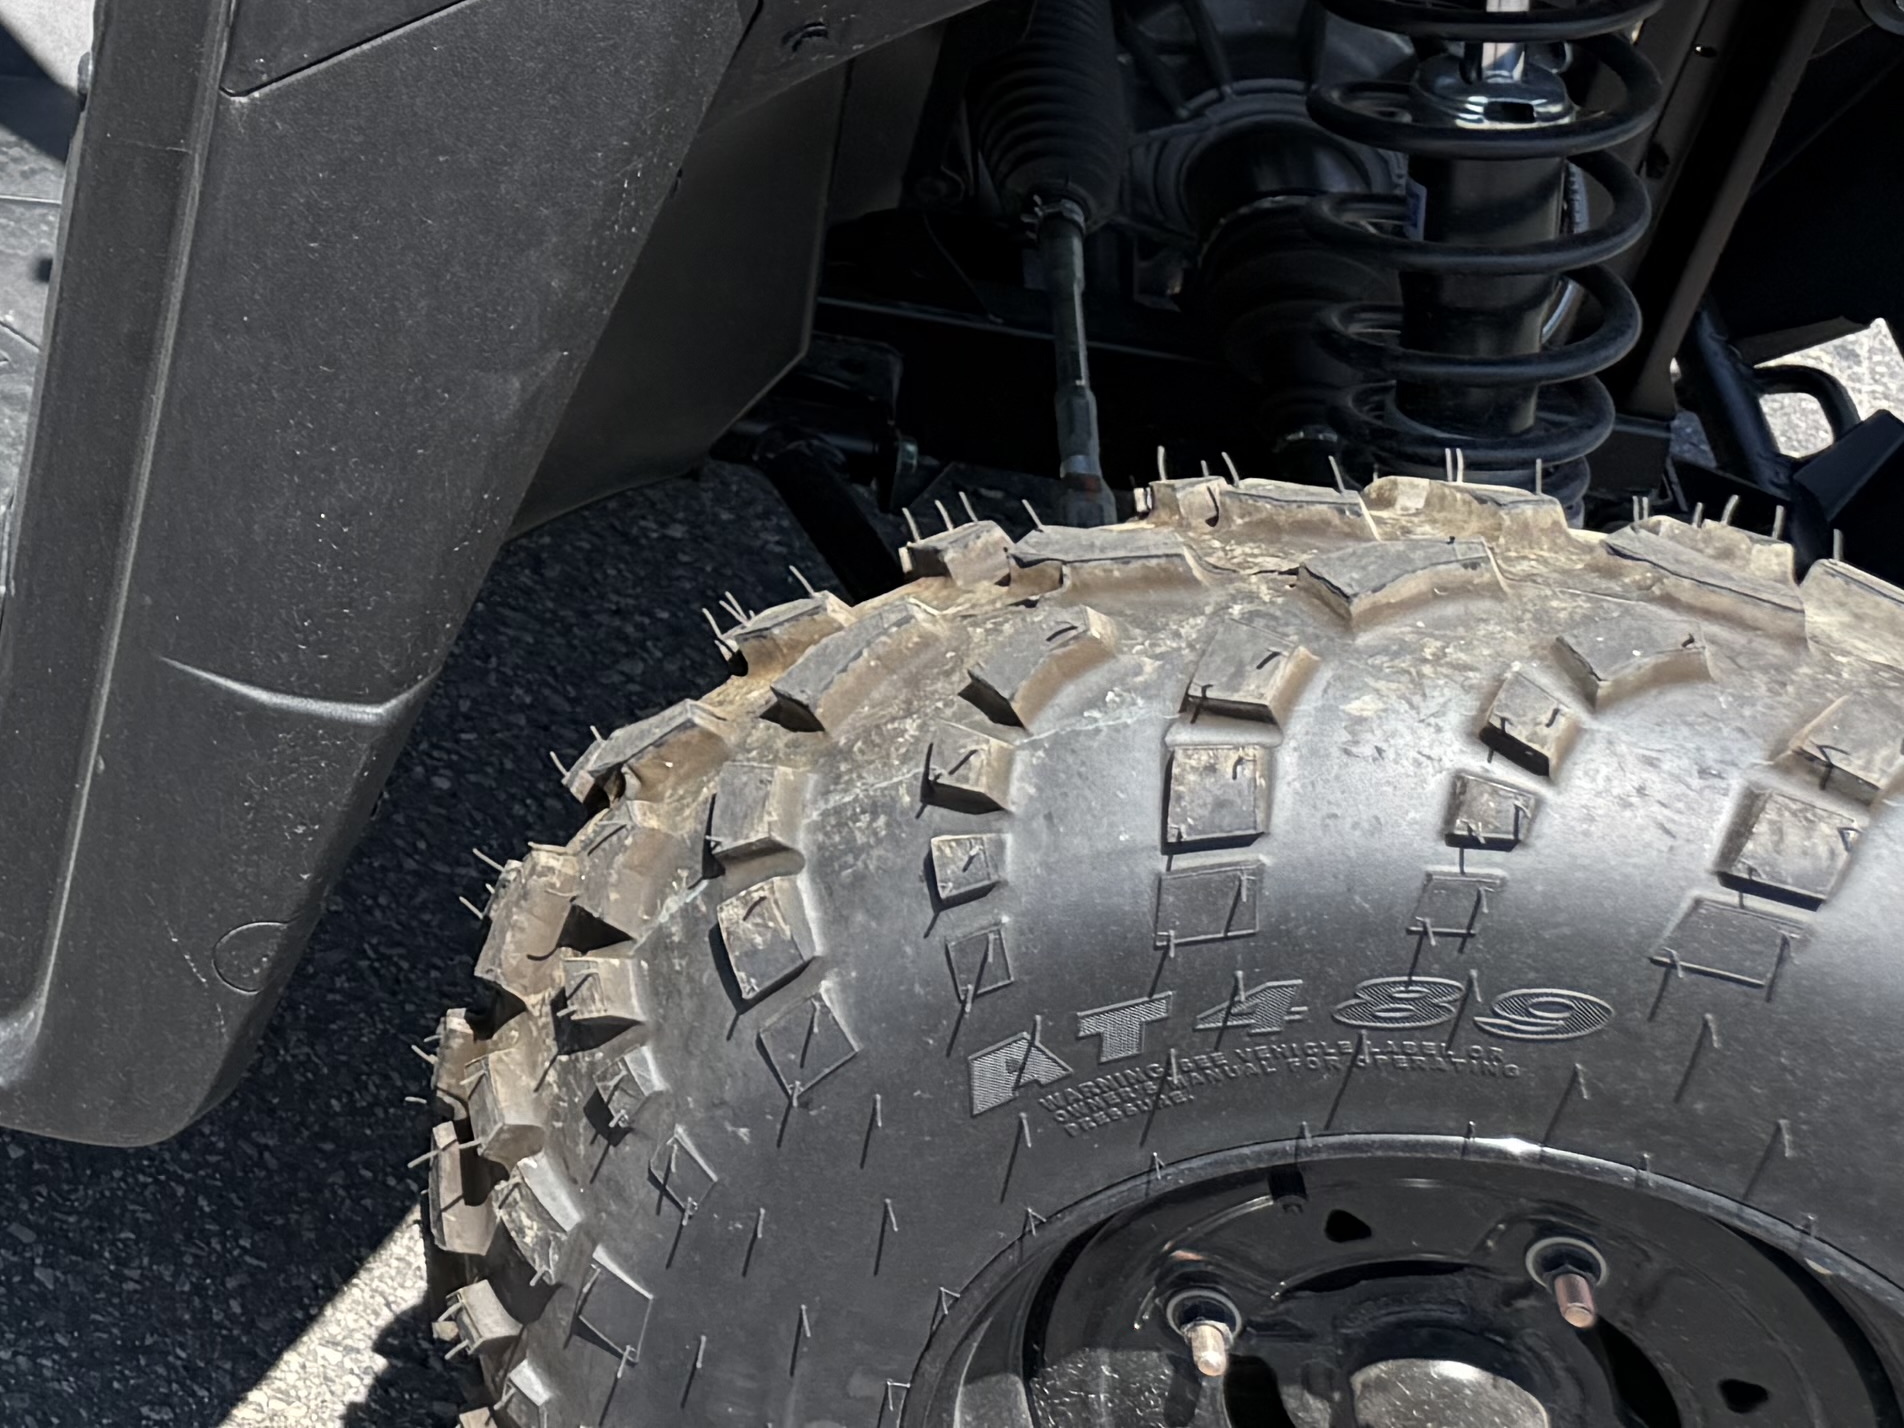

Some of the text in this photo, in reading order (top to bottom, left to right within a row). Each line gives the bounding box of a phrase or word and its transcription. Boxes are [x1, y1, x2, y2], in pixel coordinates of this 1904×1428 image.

[1166, 1063, 1276, 1089] MANUAL
[1286, 1053, 1342, 1071] FOR
[1177, 1049, 1228, 1074] SEE
[1234, 1038, 1354, 1061] VEHICLE
[1365, 1038, 1455, 1055] LABEL
[1467, 1043, 1505, 1063] OR
